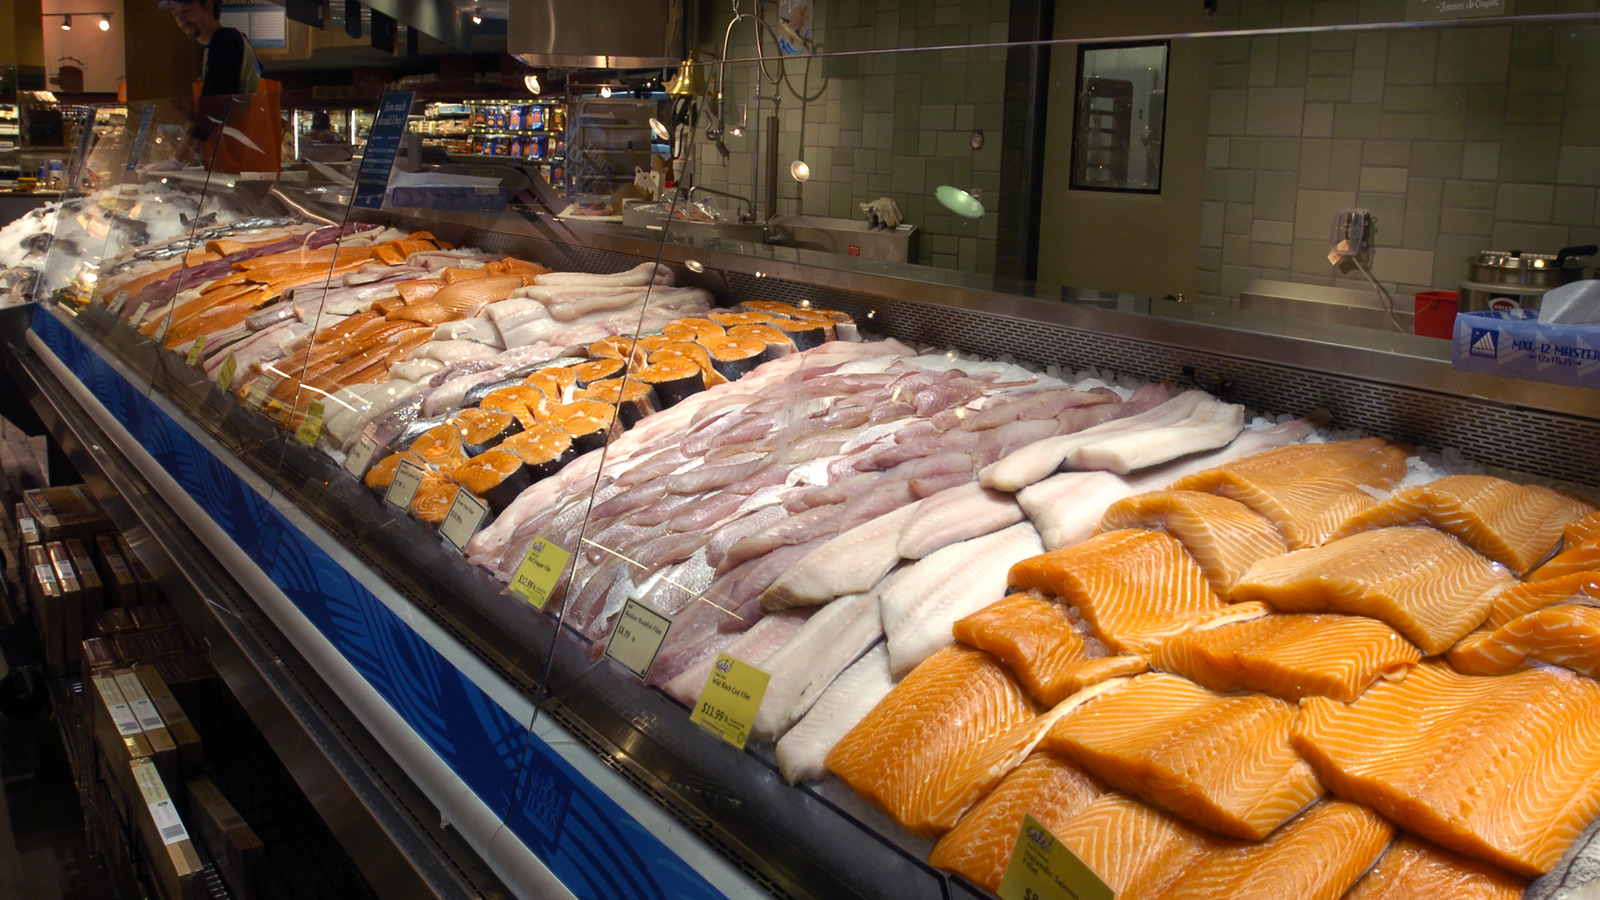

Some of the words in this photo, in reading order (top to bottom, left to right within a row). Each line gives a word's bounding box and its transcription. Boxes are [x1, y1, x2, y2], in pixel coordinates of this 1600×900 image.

[384, 101, 394, 112] How
[394, 100, 406, 111] much
[518, 574, 534, 589] $12.99
[617, 625, 631, 638] $8.99
[637, 617, 653, 629] Rockfish
[712, 677, 721, 687] Wild
[720, 682, 732, 692] Black
[731, 687, 741, 696] Cod
[741, 690, 751, 701] Fillet
[701, 702, 725, 721] $11.99
[531, 770, 565, 816] WHOLE
[526, 790, 559, 830] FOODS
[1022, 857, 1038, 876] Fillet
[1025, 849, 1054, 879] Icelandic
[1054, 875, 1079, 900] Salmon
